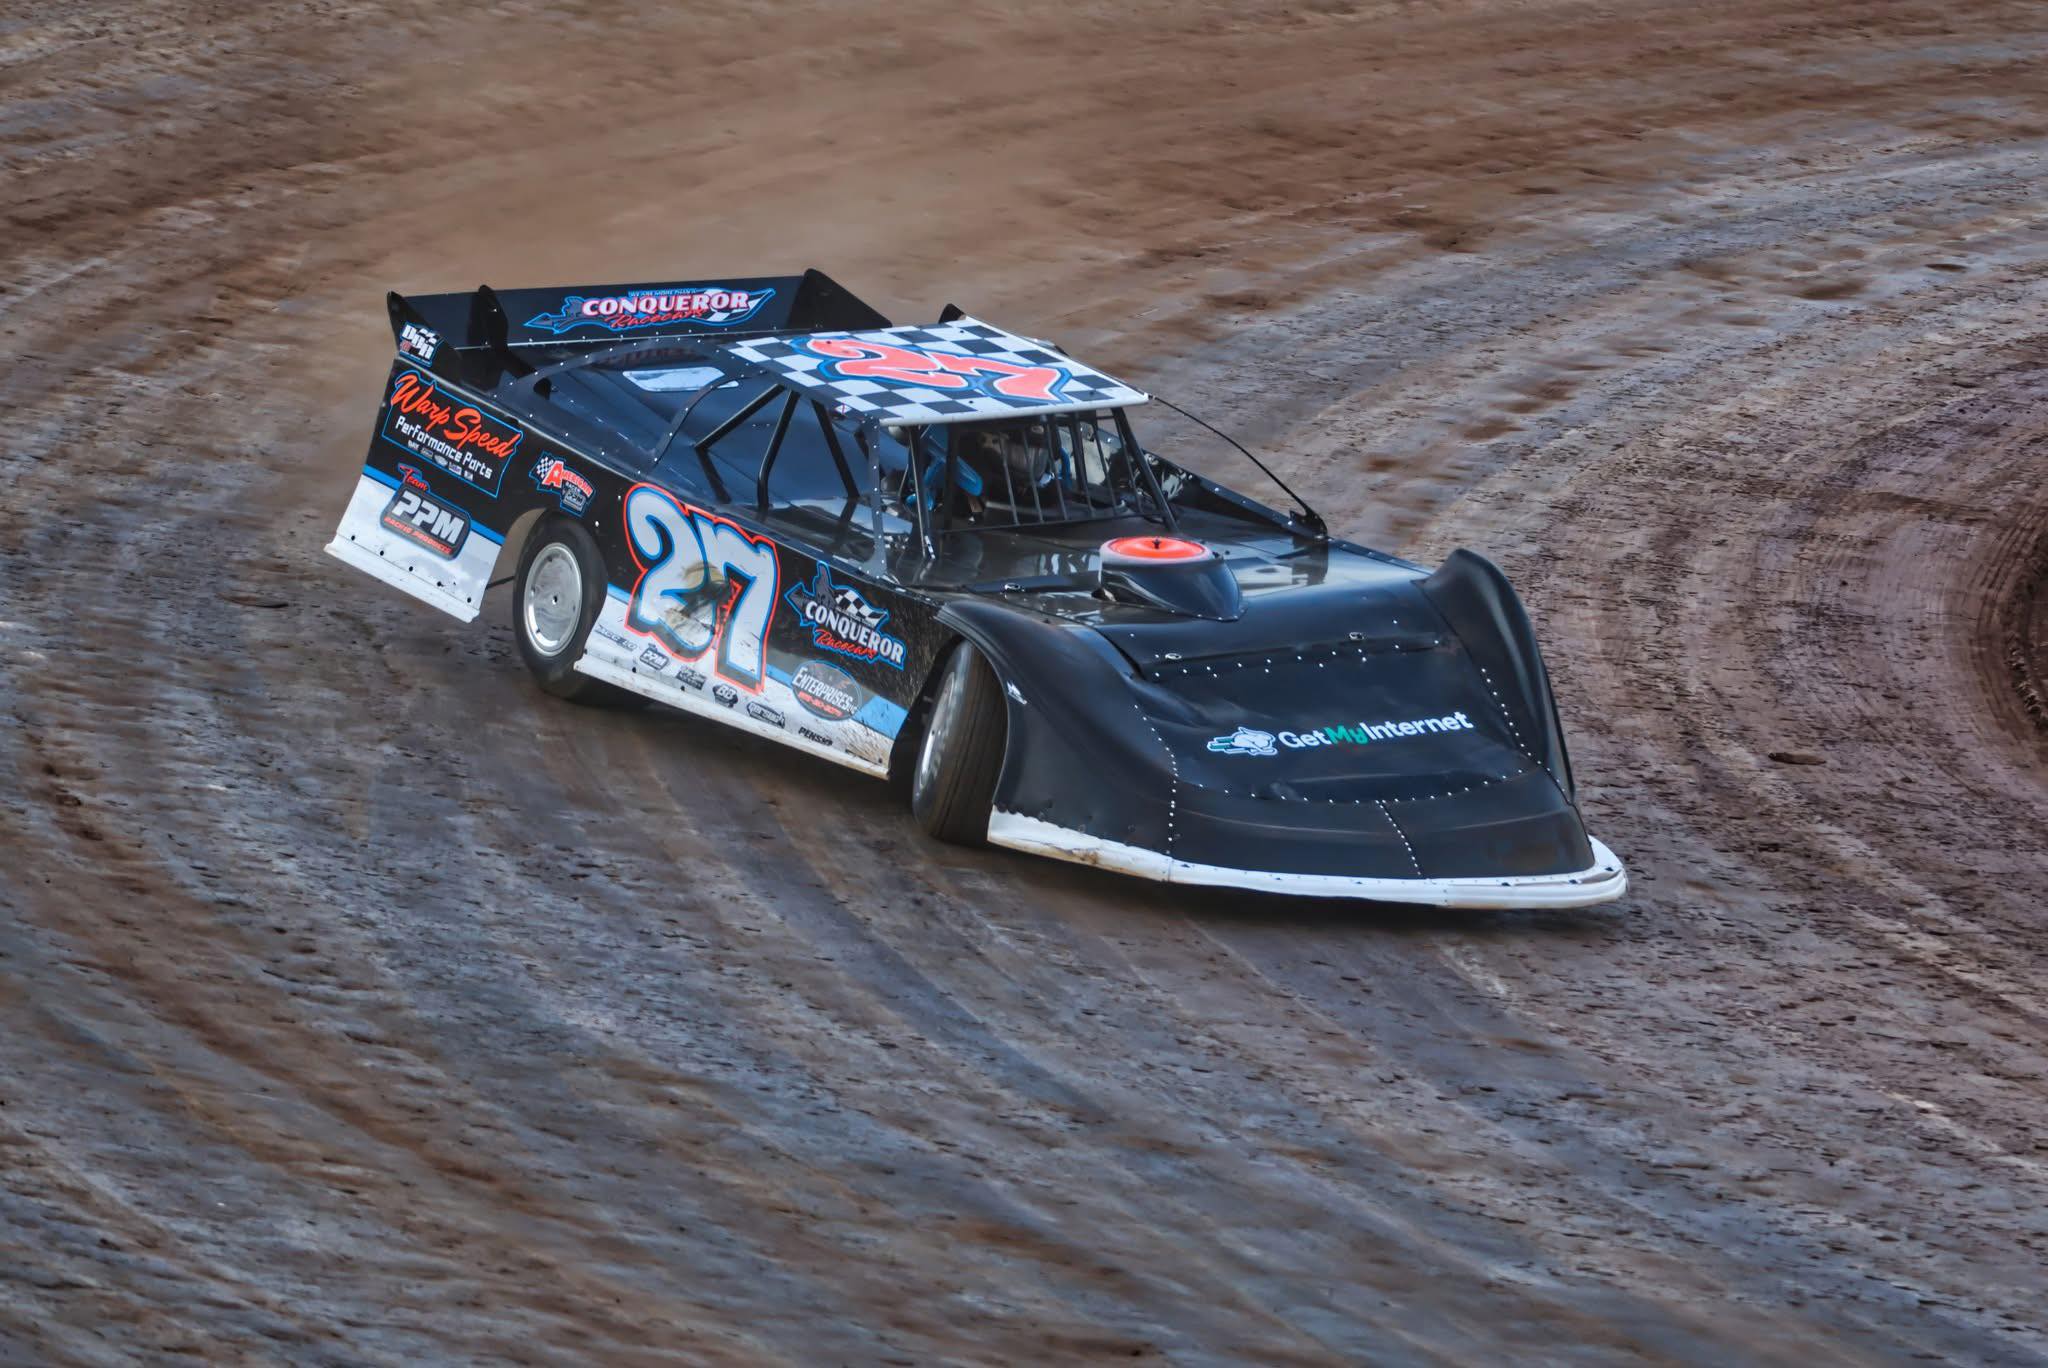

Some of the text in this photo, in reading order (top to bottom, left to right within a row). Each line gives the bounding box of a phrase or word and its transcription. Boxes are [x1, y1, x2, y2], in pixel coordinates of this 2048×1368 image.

[581, 290, 750, 316] CONQUEROR
[604, 308, 709, 328] Racecars
[794, 336, 1066, 401] 27
[391, 374, 521, 458] Warp Speed
[395, 415, 466, 462] Performance
[462, 451, 493, 480] Parts
[399, 465, 428, 491] Team
[541, 460, 594, 498] AMERICAN
[391, 489, 465, 544] PPM
[624, 483, 780, 695] 27
[805, 600, 904, 664] CONQUEROR
[814, 628, 879, 659] Racecars
[791, 666, 854, 711] ENTERPRISES
[1277, 711, 1475, 748] GetMyInternet
